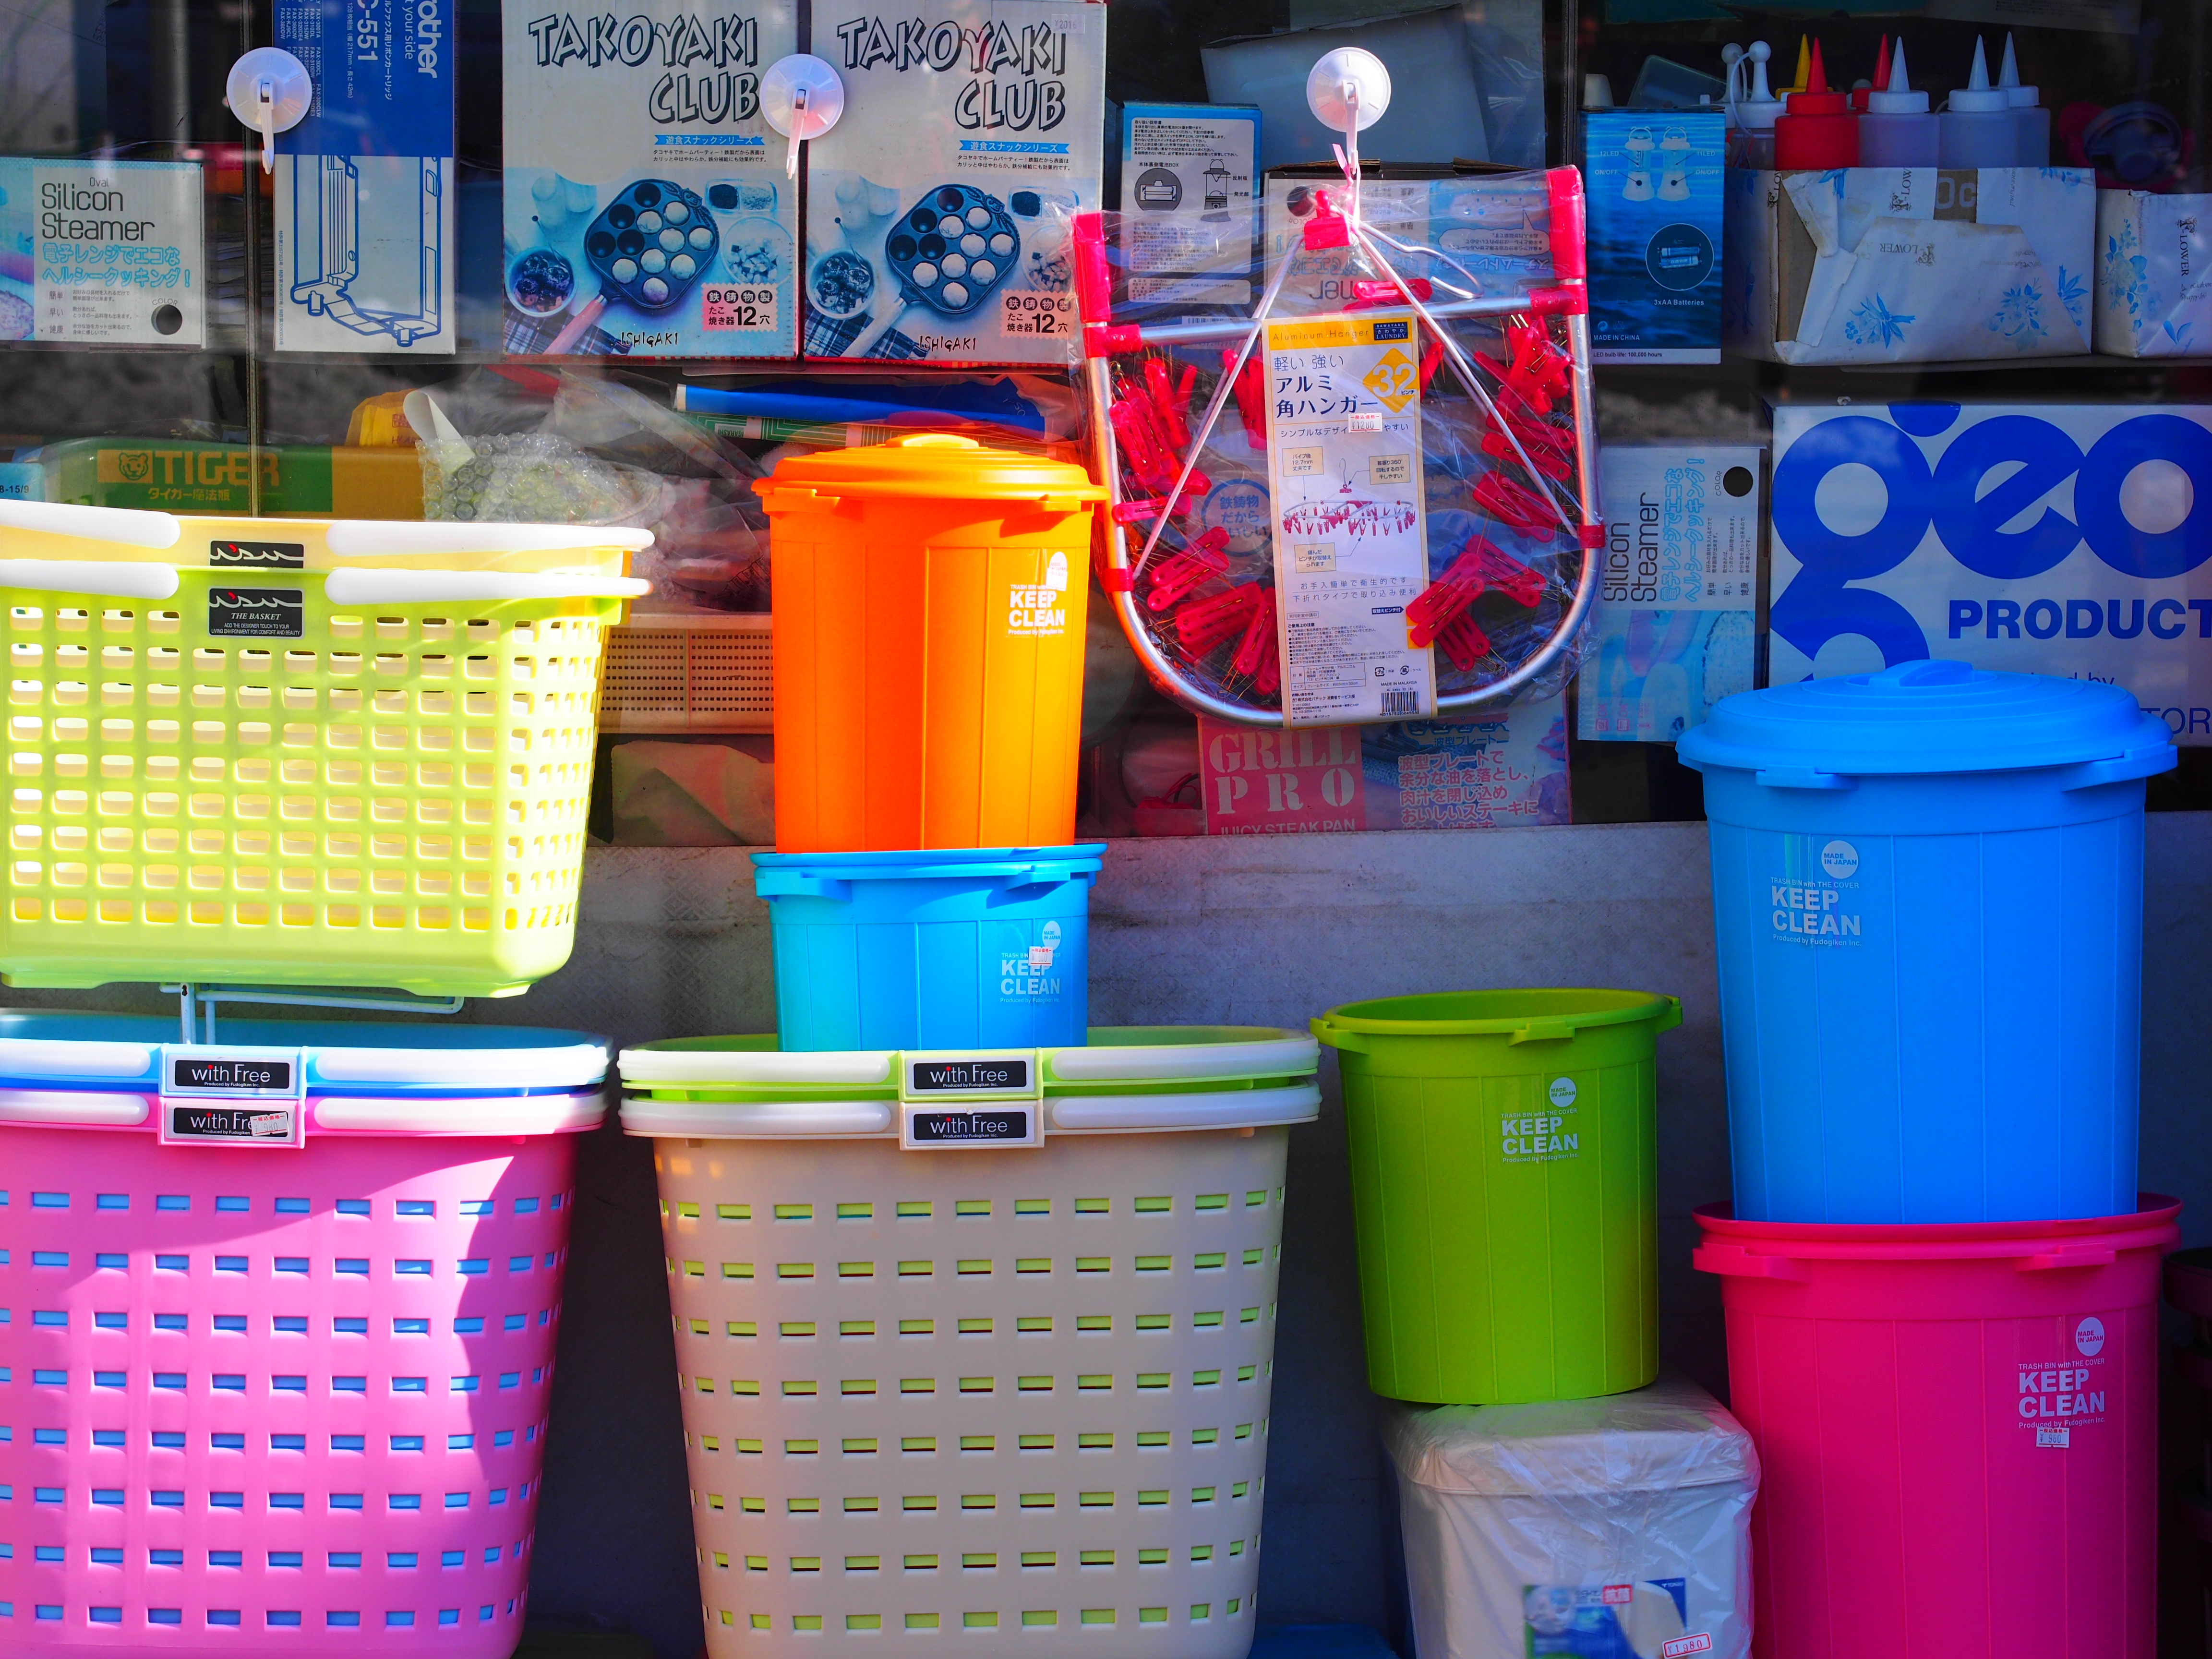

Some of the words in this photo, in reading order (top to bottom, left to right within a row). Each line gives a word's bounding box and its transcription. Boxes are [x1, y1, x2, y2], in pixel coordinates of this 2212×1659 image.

[402, 7, 414, 34] your
[405, 36, 415, 60] side
[528, 12, 758, 69] TAKOYAKI
[837, 15, 1066, 76] TAKOYAKI
[649, 71, 759, 124] CLUB
[955, 78, 1066, 132] CLUB
[665, 135, 754, 145] 遊食スナックシリーズ
[970, 141, 1058, 153] 遊食スナックシリーズ
[89, 177, 109, 187] Oval
[42, 183, 123, 211] Silicon
[42, 213, 155, 241] Steamer
[43, 243, 180, 265] 電子レンジでエコな
[42, 266, 190, 288] ヘルシークッキング！
[49, 291, 63, 300] 簡単
[152, 298, 178, 306] COLOR
[707, 289, 773, 304] 鉄鋳物製
[49, 308, 63, 317] 早い
[709, 306, 725, 314] たこ
[709, 316, 735, 326] 焼き器
[733, 306, 757, 326] 12
[760, 314, 770, 325] 穴
[1008, 313, 1023, 322] たこ
[49, 325, 63, 334] 健康
[1007, 322, 1034, 333] 焼き器
[1032, 314, 1056, 333] 12
[1058, 323, 1068, 333] 穴
[621, 332, 678, 347] ISHIGAKI
[919, 336, 976, 352] ISHIGAKI
[1273, 332, 1323, 341] Aluminum
[1330, 329, 1369, 339] Hanger
[1274, 356, 1304, 372] 軽い
[1311, 354, 1344, 369] 強い
[1276, 375, 1332, 394] アルミ
[1372, 362, 1417, 397] 32
[1276, 396, 1378, 419] 角ハンガー
[1351, 421, 1374, 430] ¥1280
[155, 451, 279, 486] TIGER
[1714, 471, 1722, 496] COLOR
[148, 488, 230, 501] タイガー魔法瓶
[1220, 495, 1259, 510] 鉄鋳物
[1221, 510, 1260, 524] だから
[1660, 468, 1684, 603] 電子レンジでエコな
[1685, 458, 1705, 603] ヘルシークッキング！
[1631, 492, 1659, 602] Steamer
[1603, 523, 1630, 601] Silicon
[1300, 577, 1407, 590] お手入簡単で衛生的です
[1707, 582, 1716, 596] 簡単
[1724, 582, 1732, 596] 早い
[1740, 582, 1749, 596] 健康
[1010, 591, 1057, 608] KEEP
[1293, 588, 1417, 602] 下折れタイプで取り込み便利
[1009, 609, 1065, 627] CLEAN
[1209, 728, 1356, 773] GRILL
[1399, 750, 1504, 771] 波型プレートで
[1400, 766, 1528, 787] 余分な油を落とし、
[1401, 785, 1507, 806] 肉汁を閉じ込め
[1402, 801, 1538, 823] おいしいステーキに
[1323, 819, 1355, 832] PAN
[1772, 886, 1839, 911] KEEP
[1772, 910, 1861, 936] CLEAN
[1773, 934, 1800, 943] Produced
[1802, 937, 1808, 945] by
[1810, 938, 1847, 947] Fudogiken
[1001, 960, 1051, 976] KEEP
[1001, 978, 1060, 995] CLEAN
[192, 1064, 229, 1082] with
[235, 1064, 270, 1082] Free
[930, 1066, 967, 1083] with
[973, 1064, 1008, 1082] Free
[190, 1112, 228, 1129] with
[930, 1117, 967, 1133] with
[973, 1115, 1008, 1133] Free
[1502, 1116, 1562, 1136] KEEP
[1502, 1133, 1578, 1155] CLEAN
[2019, 1369, 2089, 1394] KEEP
[2019, 1391, 2104, 1418] CLEAN
[2019, 1420, 2052, 1429] Produced
[2065, 1419, 2094, 1427] Fudogiken
[1668, 1640, 1703, 1655] ¥1980
